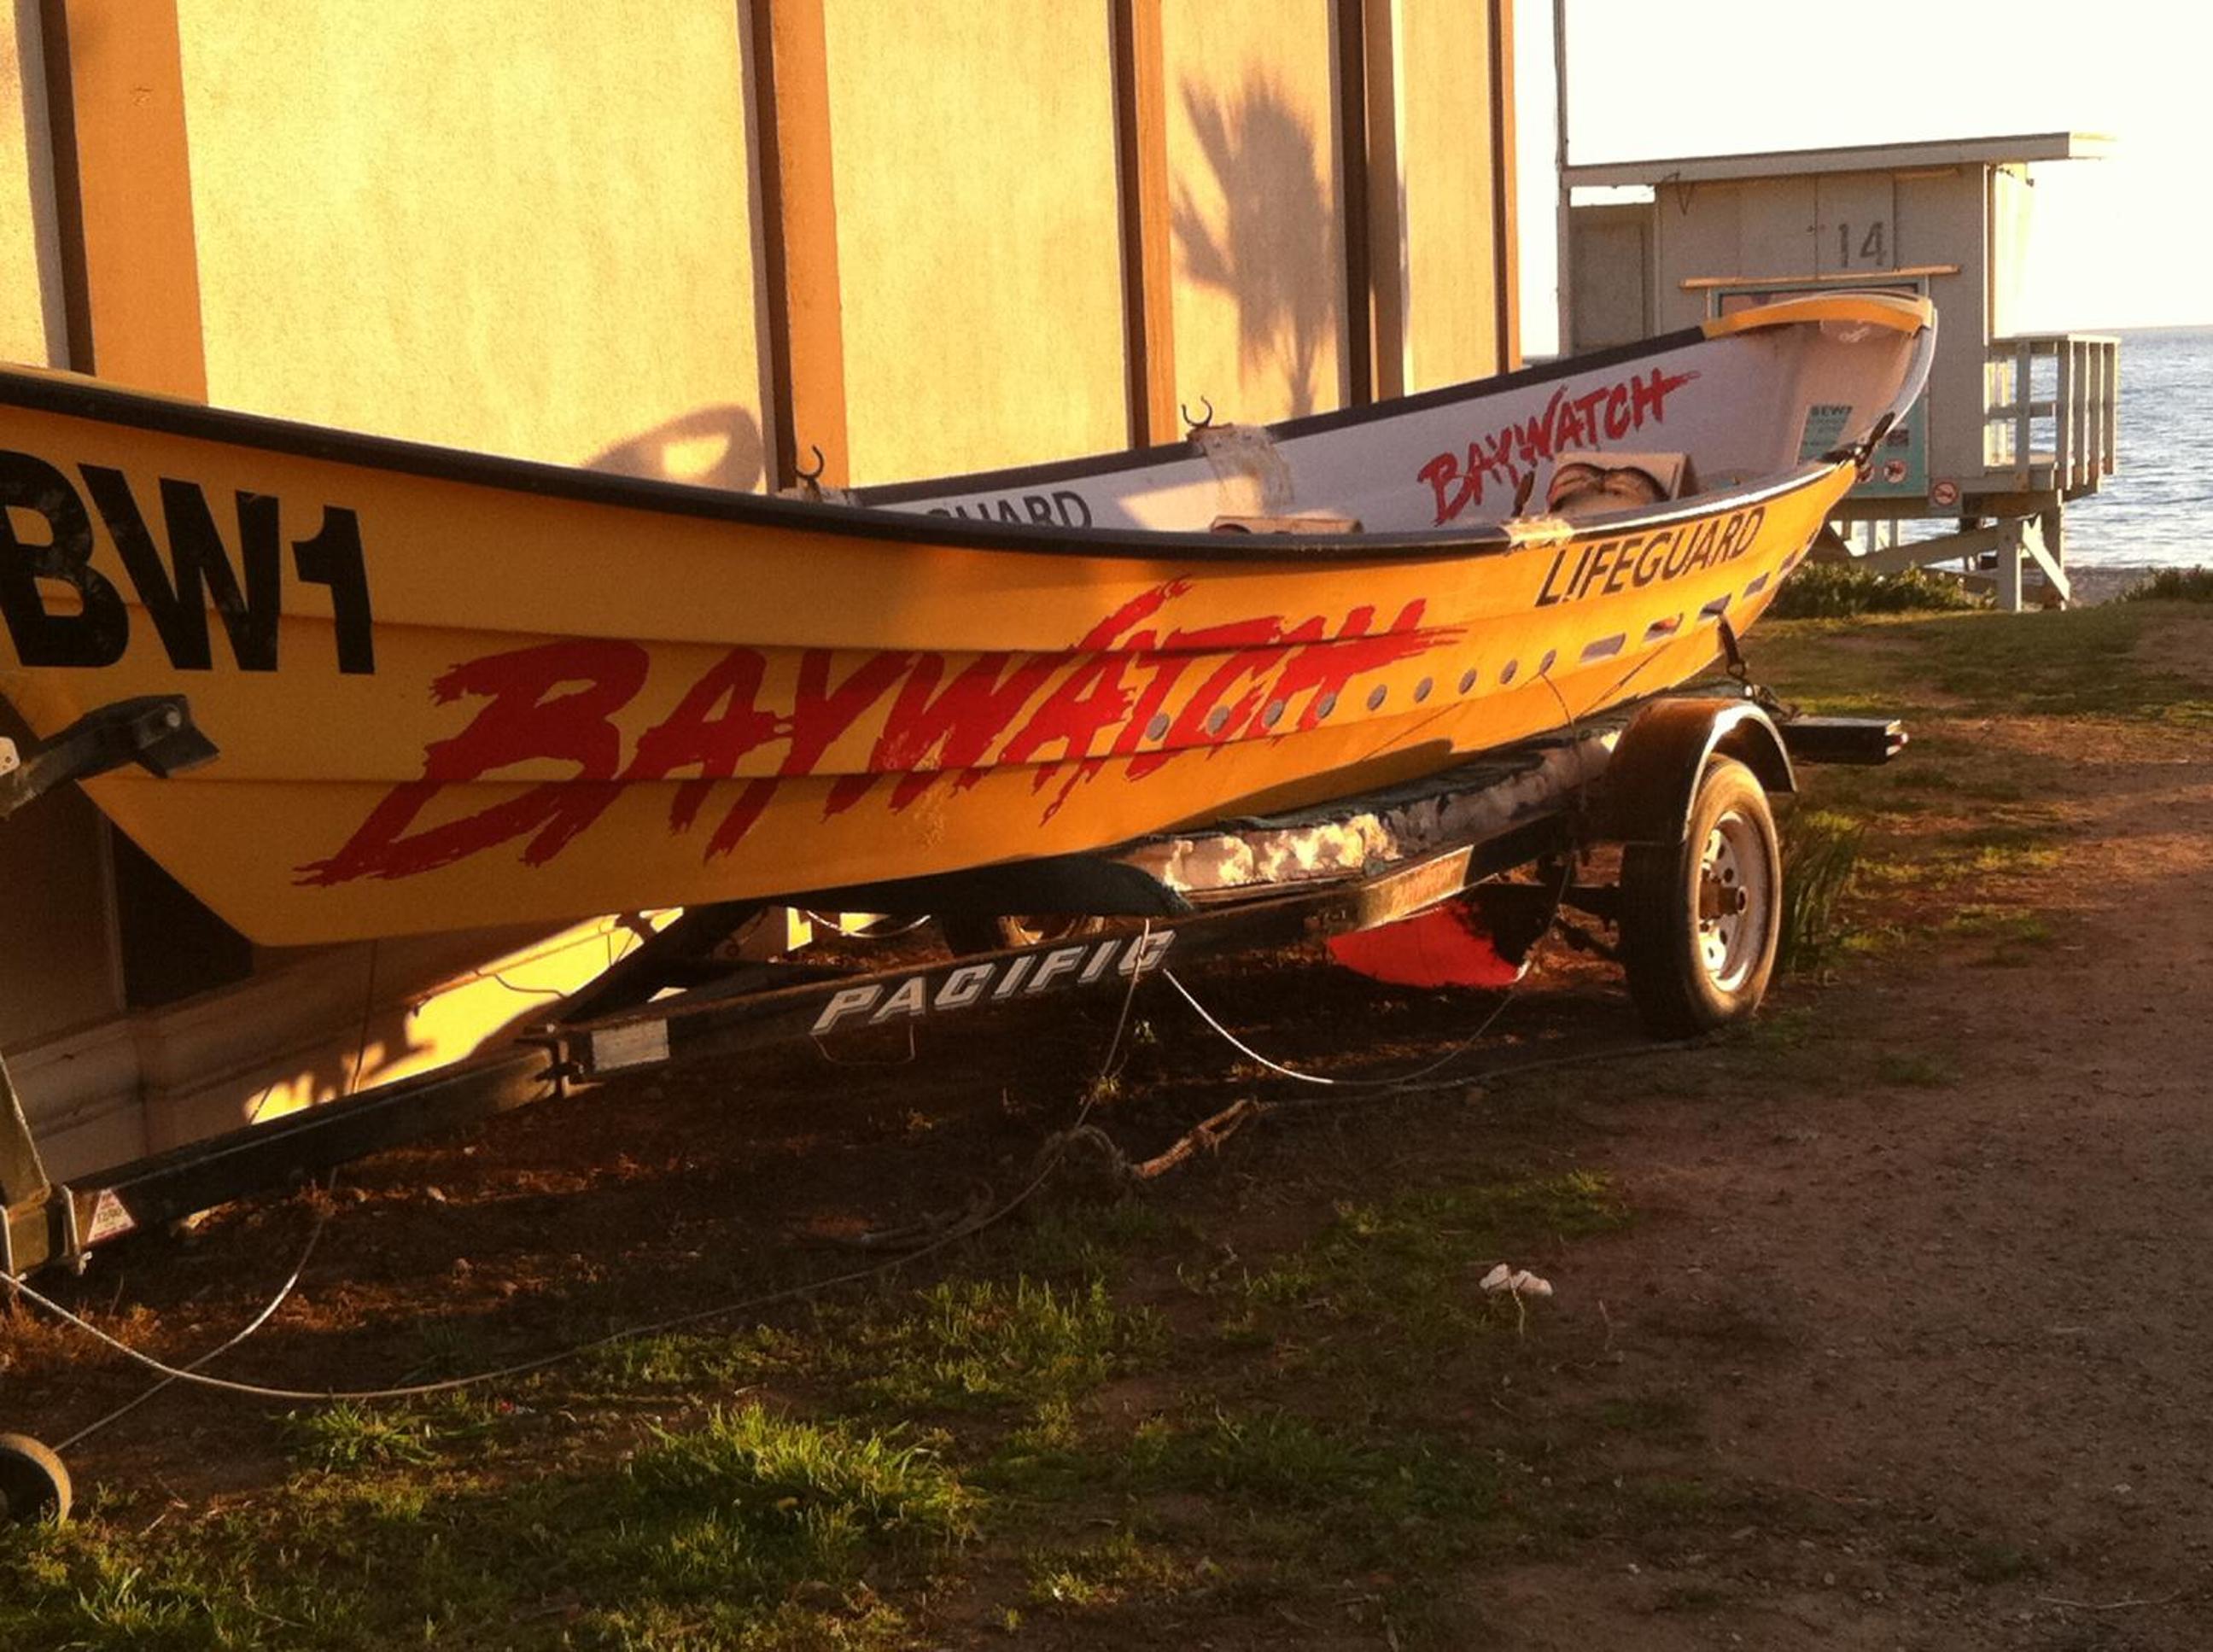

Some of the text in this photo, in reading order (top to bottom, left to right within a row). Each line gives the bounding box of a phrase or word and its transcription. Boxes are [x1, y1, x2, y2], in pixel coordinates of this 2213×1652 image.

[1838, 222, 1888, 268] 14
[1417, 367, 1702, 528] BAYWATCH
[1534, 506, 1766, 608] LIFEGUARD
[290, 574, 1469, 887] BAYWATCH
[809, 930, 1177, 1036] PACIFIC
